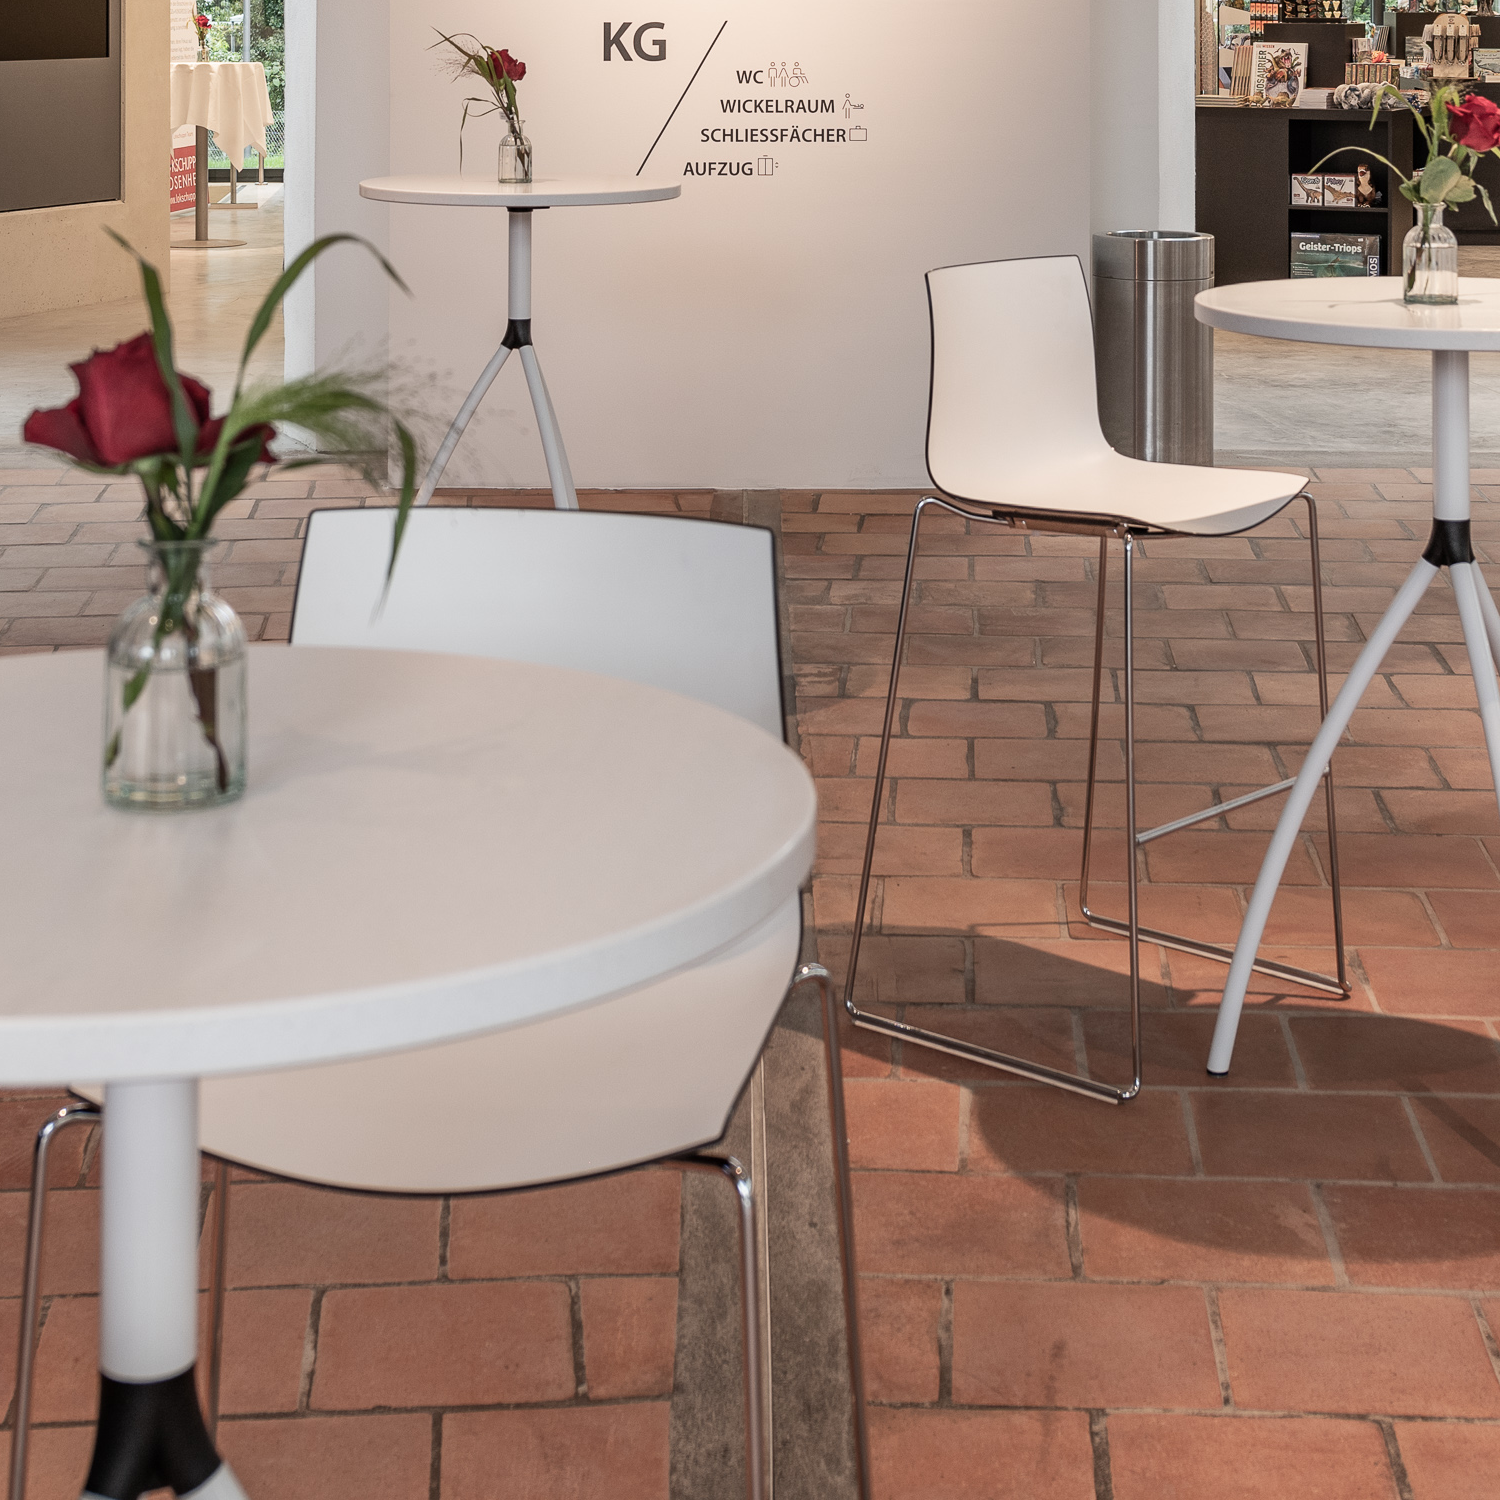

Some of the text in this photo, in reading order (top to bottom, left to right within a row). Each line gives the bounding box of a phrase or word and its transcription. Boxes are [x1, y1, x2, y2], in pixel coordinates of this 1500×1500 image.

[603, 21, 667, 62] KG
[736, 70, 764, 85] WC
[1256, 50, 1267, 93] NOSAURIER
[720, 99, 835, 114] WICKELRAUM
[701, 125, 847, 143] SCHLIESSFÄCHER
[683, 161, 753, 176] AUFZUG
[170, 173, 196, 190] OSENHE
[1299, 242, 1362, 255] Geister-Triops
[1369, 257, 1378, 277] MOS
